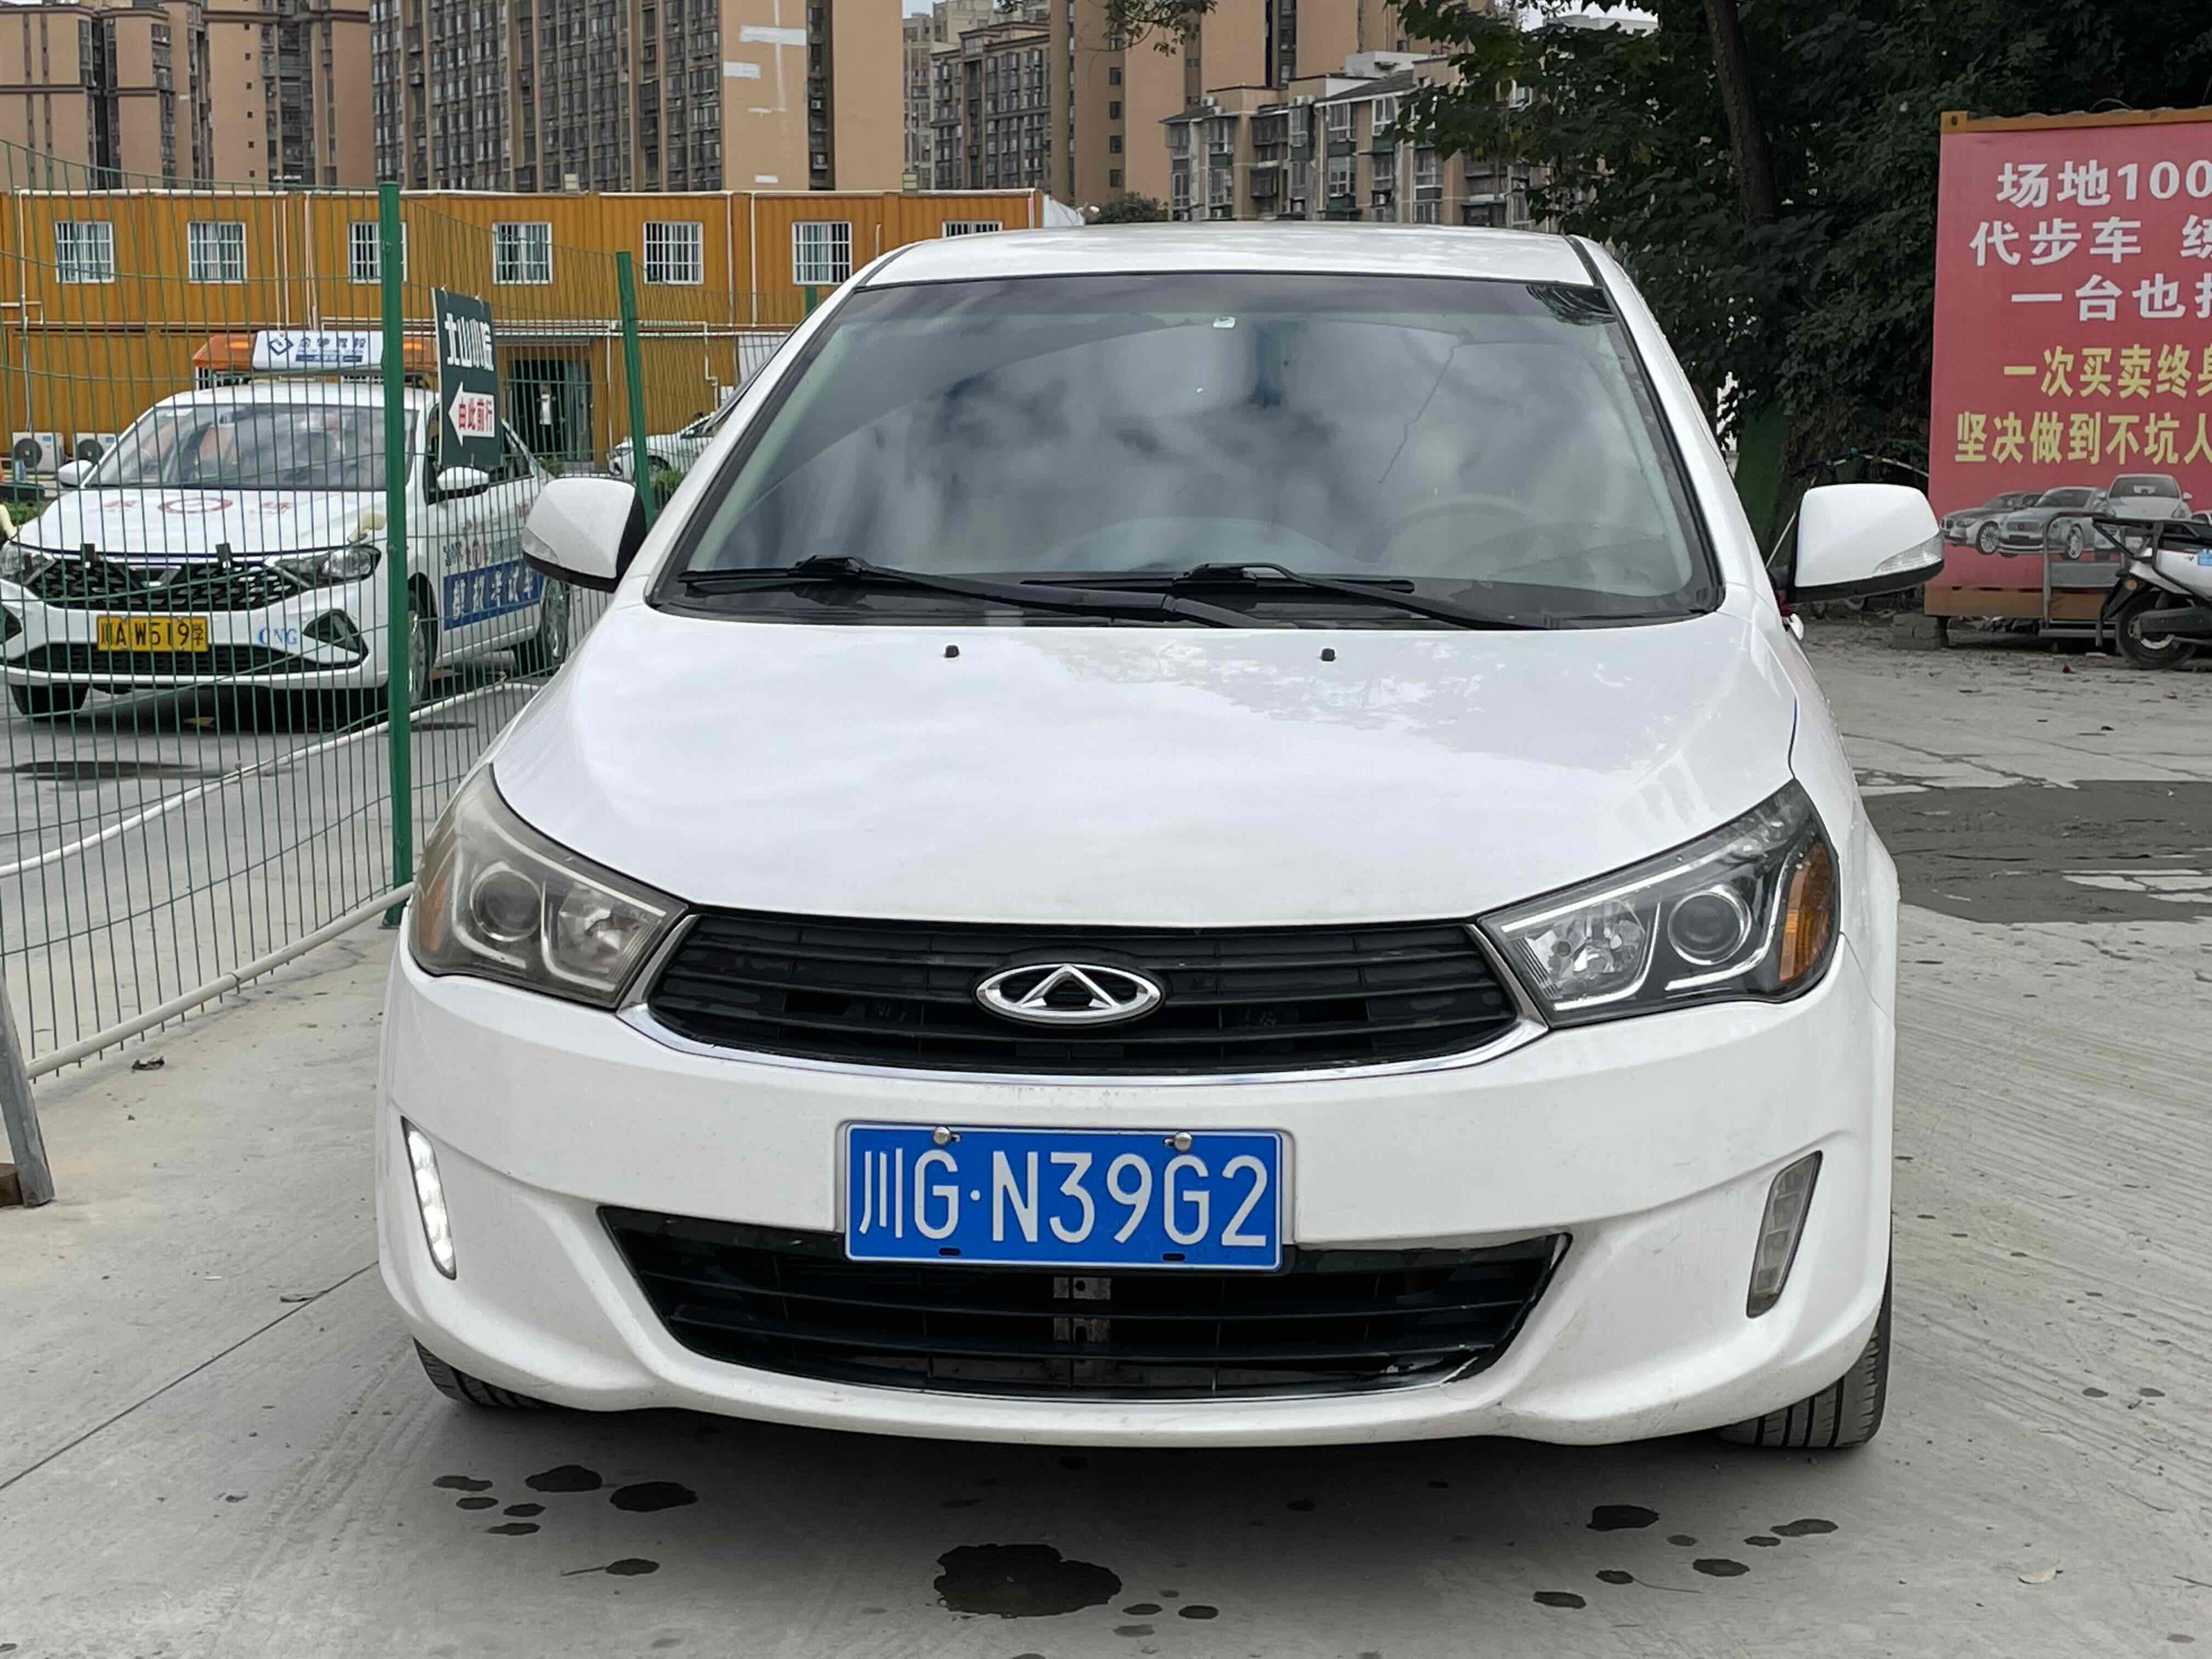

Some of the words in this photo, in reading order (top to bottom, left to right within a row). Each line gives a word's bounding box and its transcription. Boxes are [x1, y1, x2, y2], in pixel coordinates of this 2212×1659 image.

[1997, 159, 2212, 208] 场地100
[1970, 216, 2141, 266] 代步车
[1954, 411, 2212, 465] 坚决做到不坑人
[859, 1147, 1269, 1248] 川G·N39G2
